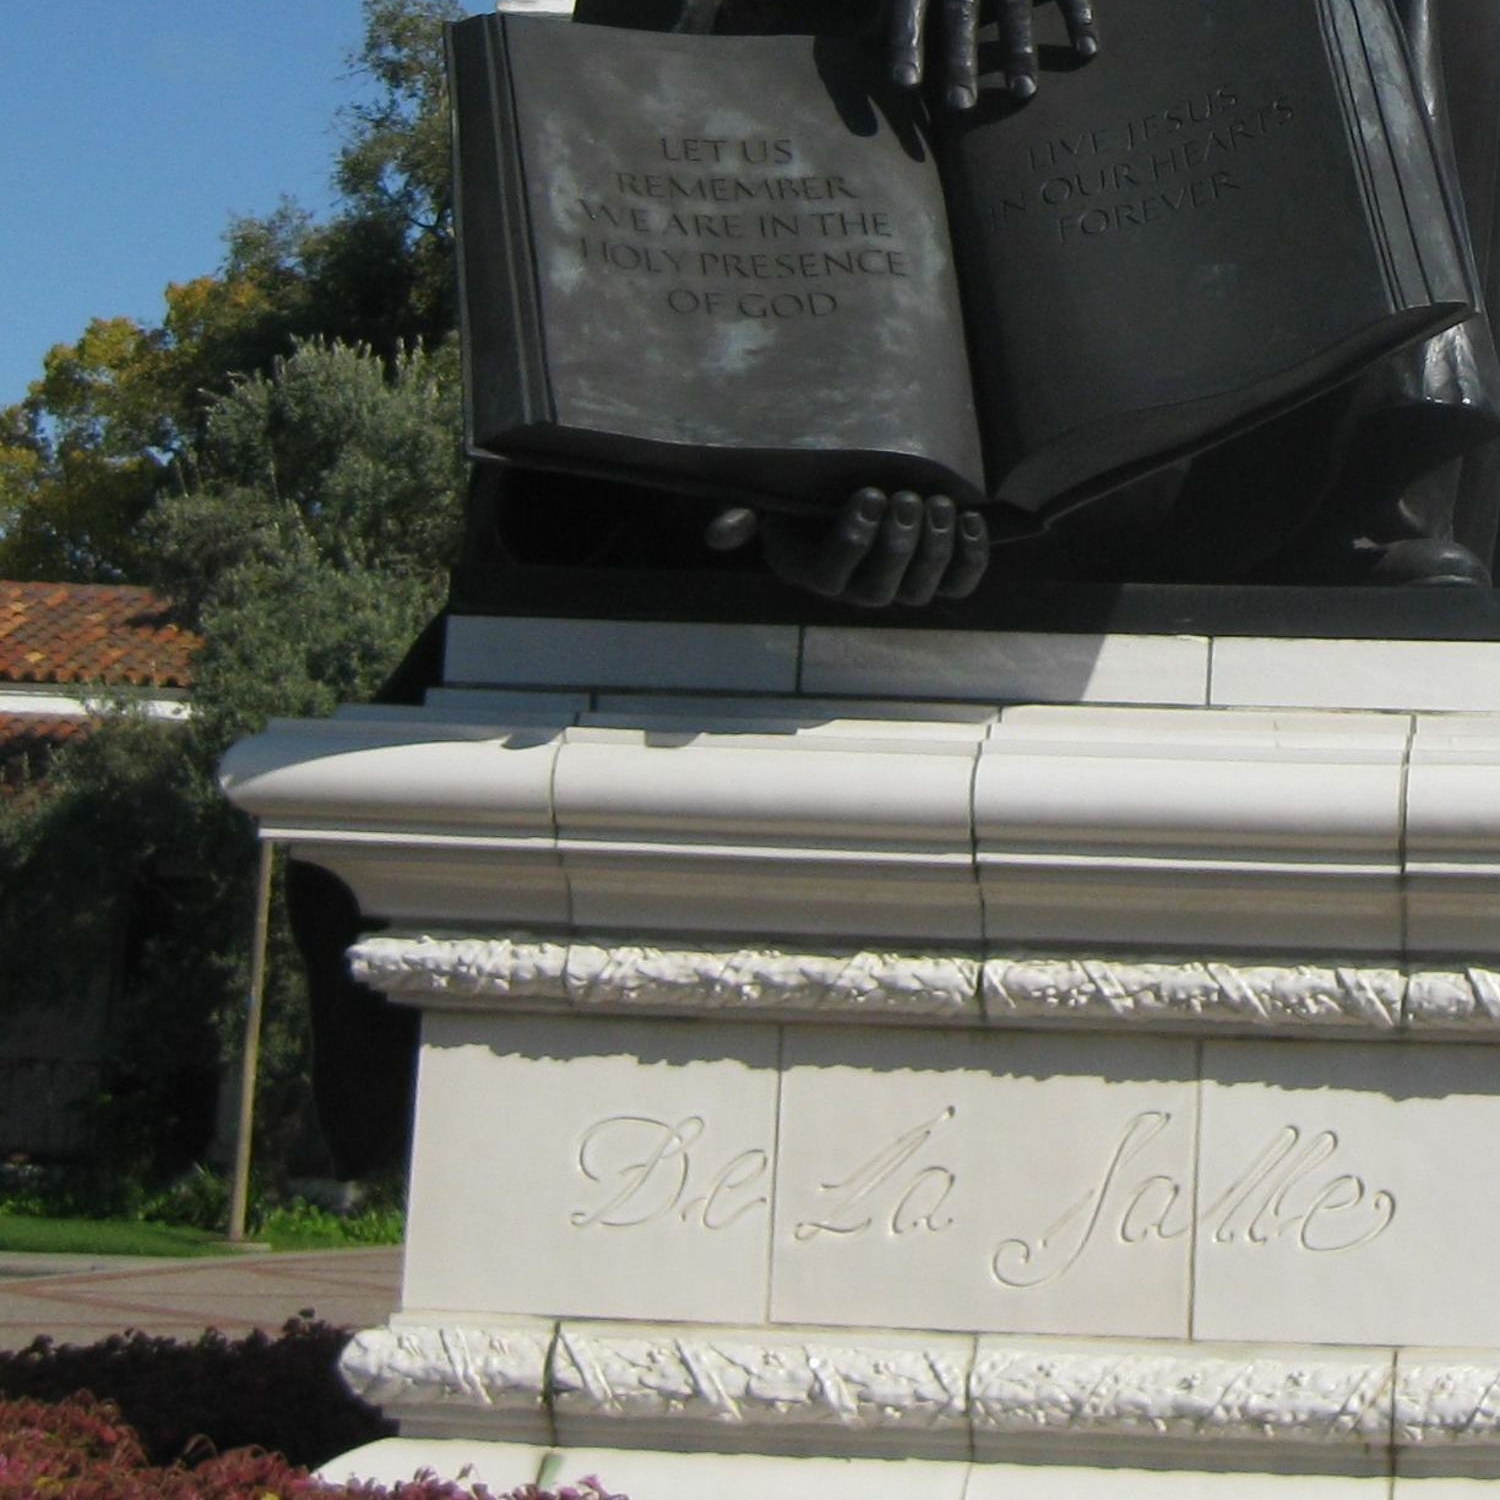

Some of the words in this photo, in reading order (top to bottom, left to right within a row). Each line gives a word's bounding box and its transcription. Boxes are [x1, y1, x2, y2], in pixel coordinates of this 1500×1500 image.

[660, 137, 727, 163] LET
[741, 138, 794, 164] US
[1028, 128, 1106, 170] LIVE
[1126, 88, 1238, 150] JESUS
[617, 172, 860, 201] REMEMBER
[989, 190, 1027, 233] IN
[1040, 162, 1140, 206] OUR
[1151, 101, 1294, 180] HEARTS
[578, 198, 651, 233] WE
[662, 213, 742, 239] ARE
[759, 213, 799, 239] IN
[810, 212, 894, 239] THE
[1057, 170, 1243, 242] FOREVER
[580, 237, 685, 275] HOLY
[699, 249, 911, 280] PRESENCE
[667, 288, 726, 317] OF
[737, 292, 839, 319] GOD
[570, 1115, 769, 1231] De
[794, 1105, 956, 1241] La
[992, 1110, 1398, 1289] Salle
